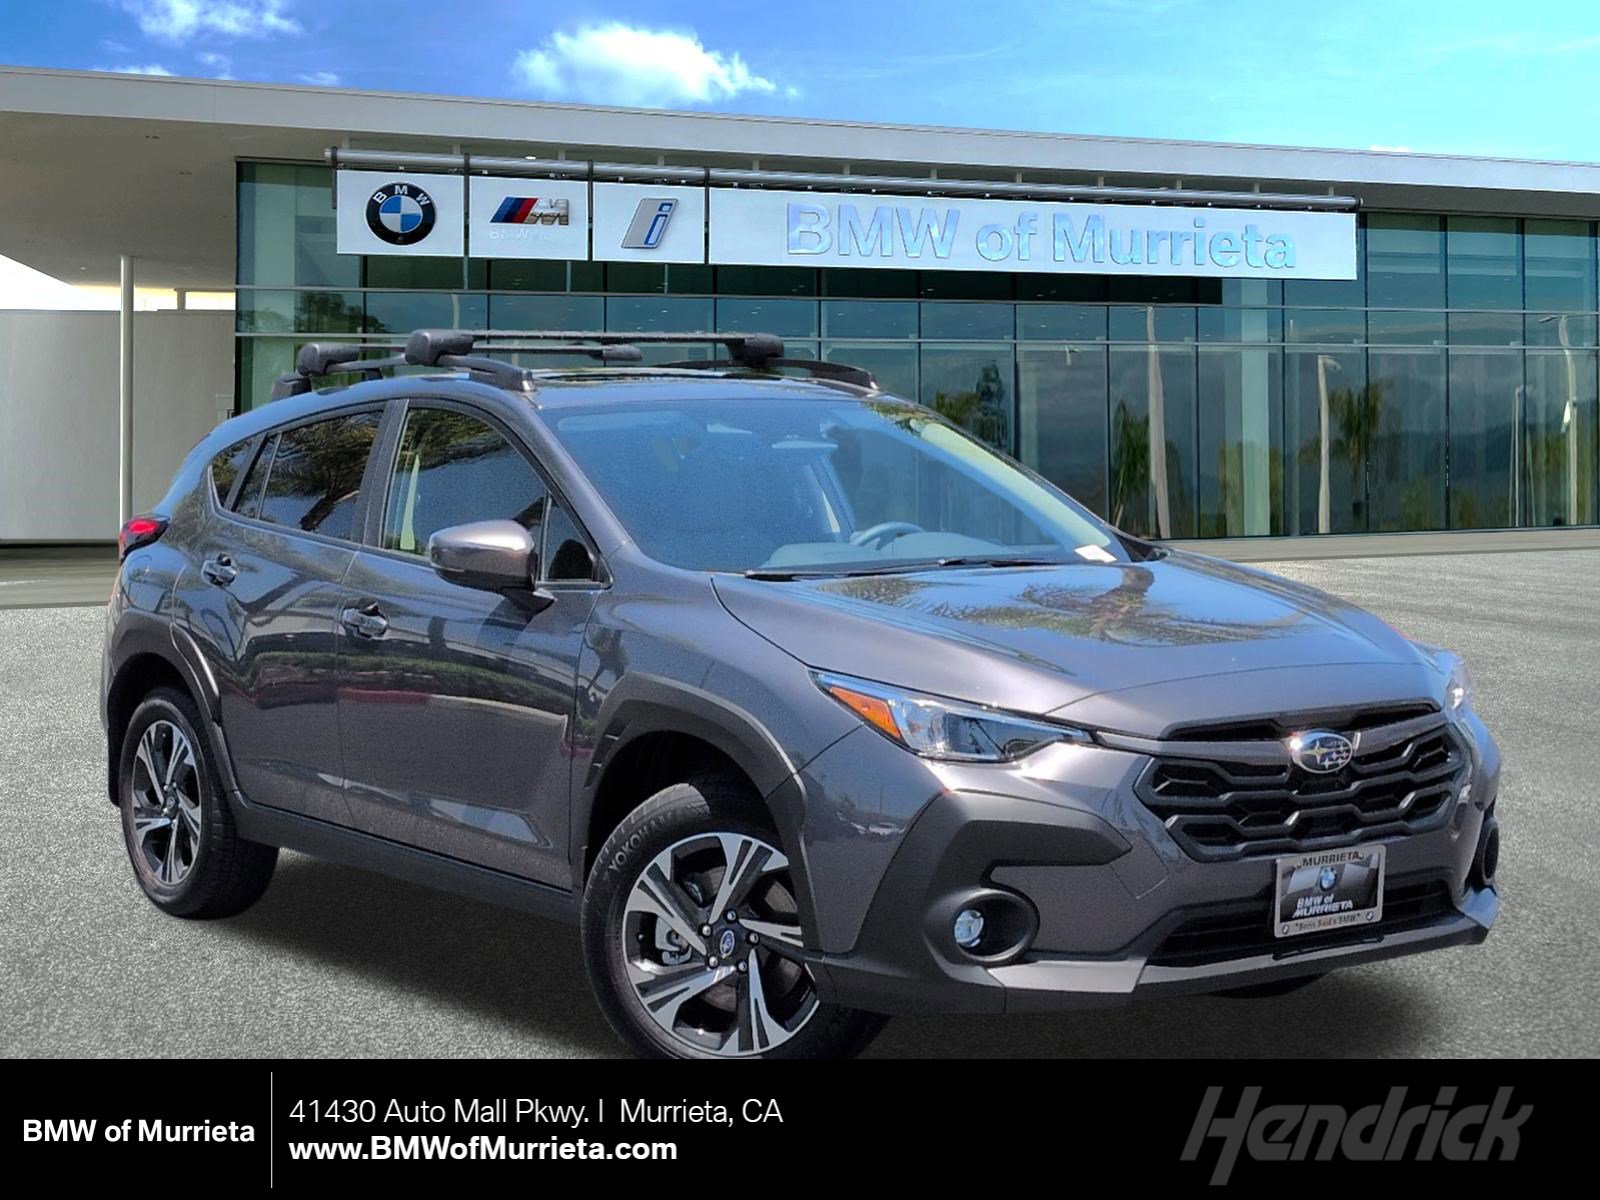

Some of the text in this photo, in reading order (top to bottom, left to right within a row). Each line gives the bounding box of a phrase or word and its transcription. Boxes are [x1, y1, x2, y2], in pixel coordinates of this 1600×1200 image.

[373, 185, 430, 206] BMW
[787, 203, 1296, 269] BMW of Murrieta
[1302, 851, 1360, 867] MURRIETA
[1292, 900, 1354, 918] MURRIETA
[1297, 893, 1335, 909] BMW of
